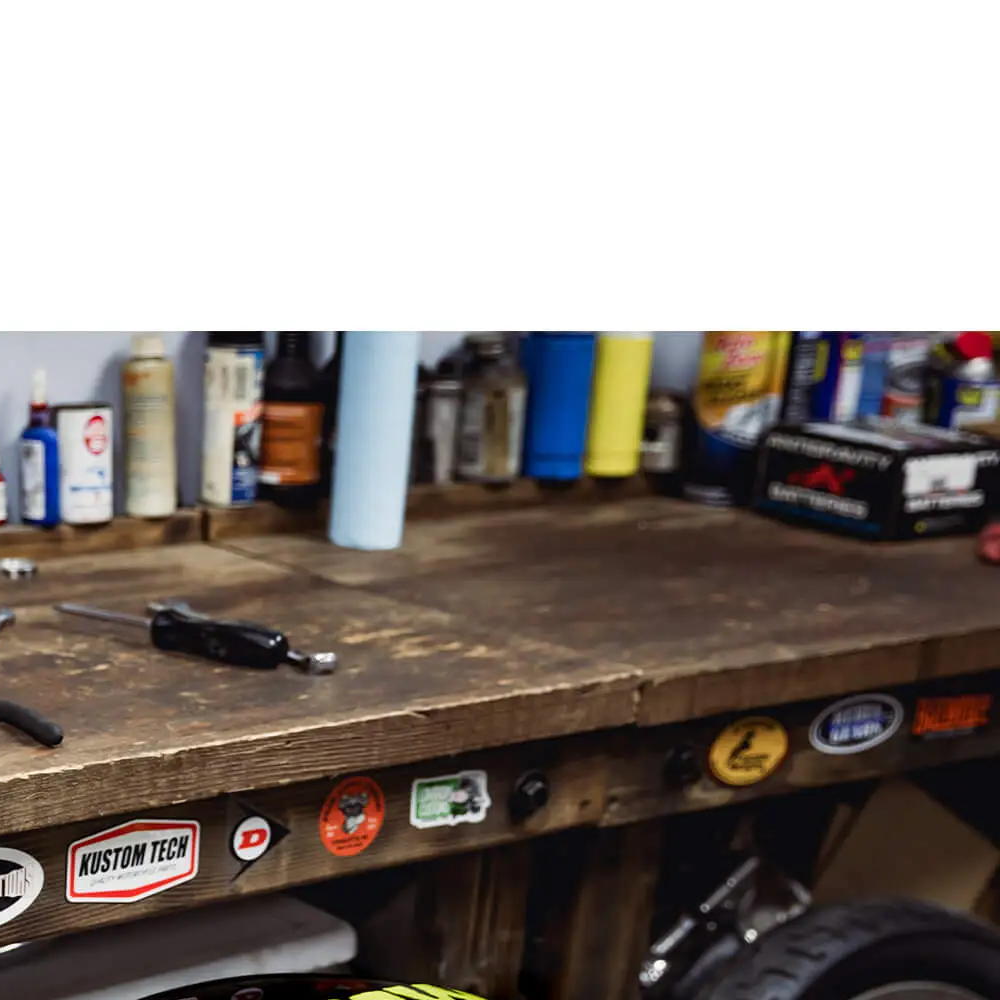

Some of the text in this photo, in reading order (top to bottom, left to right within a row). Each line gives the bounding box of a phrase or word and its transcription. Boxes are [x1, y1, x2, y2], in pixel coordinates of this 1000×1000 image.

[239, 828, 268, 850] D
[78, 835, 190, 878] KUSTOM TECH
